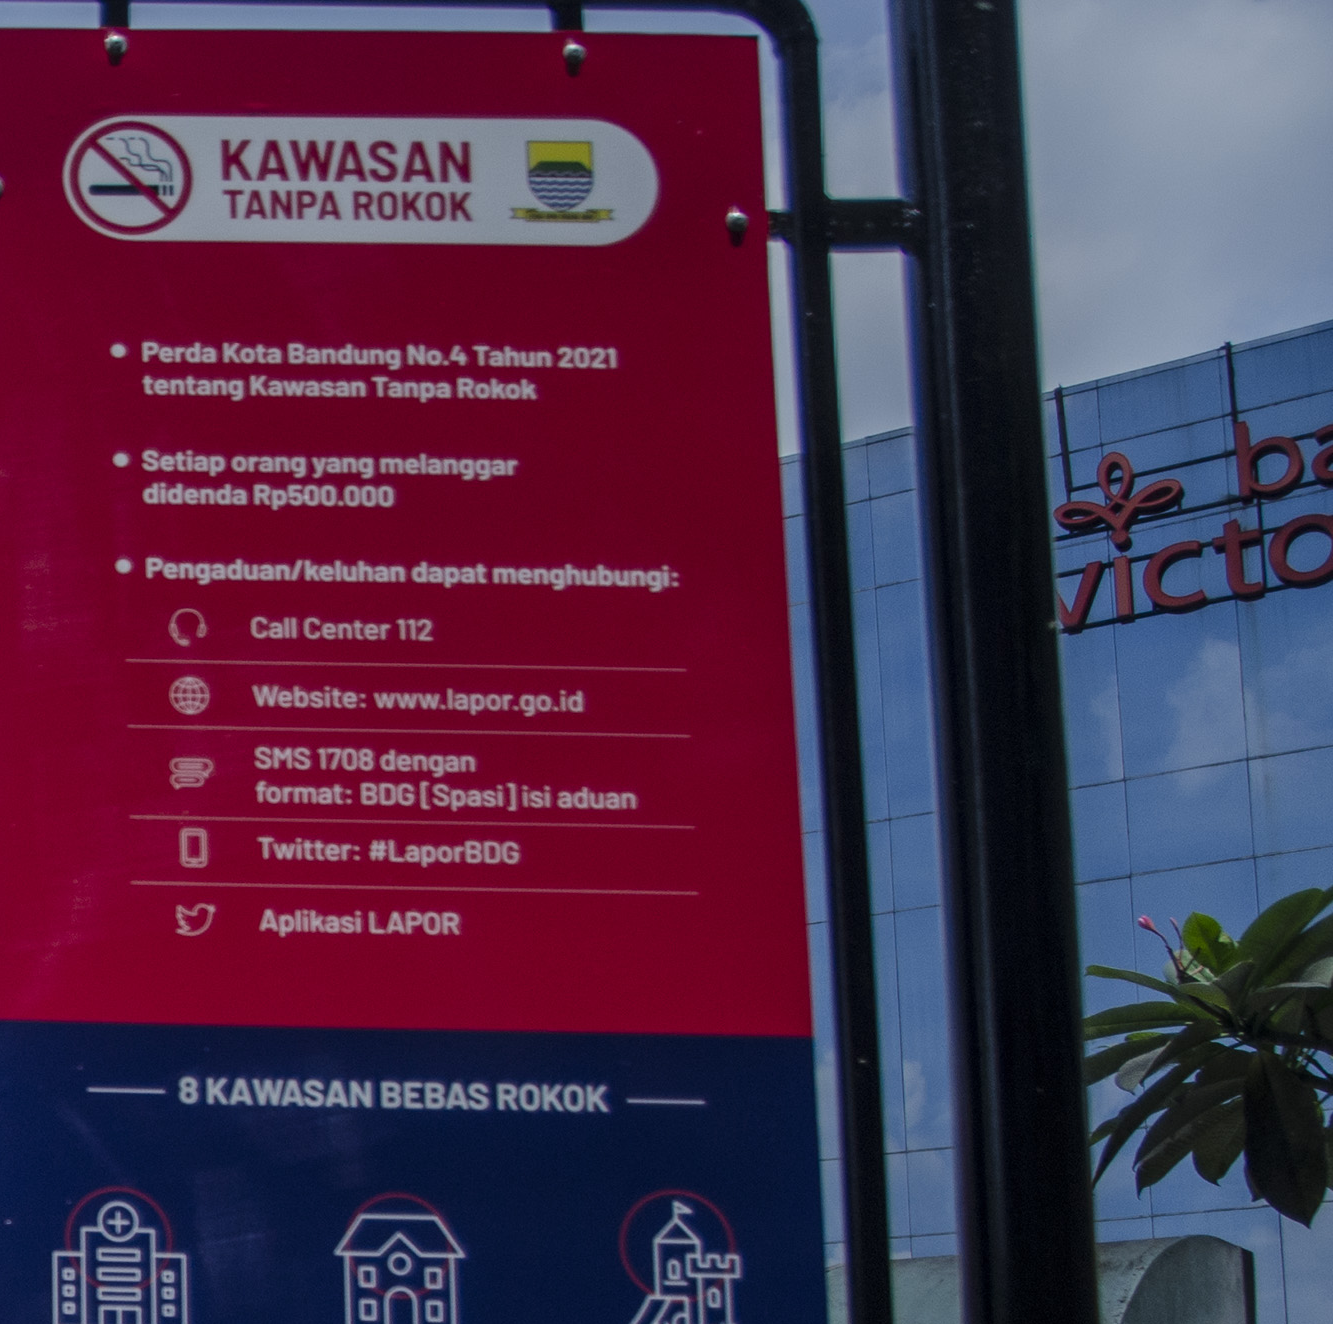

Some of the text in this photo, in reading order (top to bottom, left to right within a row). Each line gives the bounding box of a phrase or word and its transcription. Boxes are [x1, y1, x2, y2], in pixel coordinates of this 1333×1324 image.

[221, 139, 472, 184] KAWASAN
[222, 189, 473, 222] TANPA ROKOK
[141, 340, 618, 371] Perda Kota Bandung No.4 Tahun 2021
[141, 374, 538, 404] tentang Kawasan Tanpa Rokok
[141, 449, 519, 481] Setiap orang yang melanggar
[142, 481, 395, 511] didenda Rp500.000
[145, 556, 679, 594] Pengaduan/keluhan dapat menghubungi:
[250, 615, 434, 642] Call Center 112
[251, 684, 585, 718] Website: www.lapor.go.id
[254, 745, 477, 778] SMS 1708 dengan
[254, 780, 638, 812] format: BDG [Spasi] isi aduan
[257, 836, 521, 868] Twitter: #LaporBDG
[259, 908, 461, 938] Aplikasi LAPOR
[178, 1075, 610, 1113] 8 KAWASAN BEBAS ROKOK
